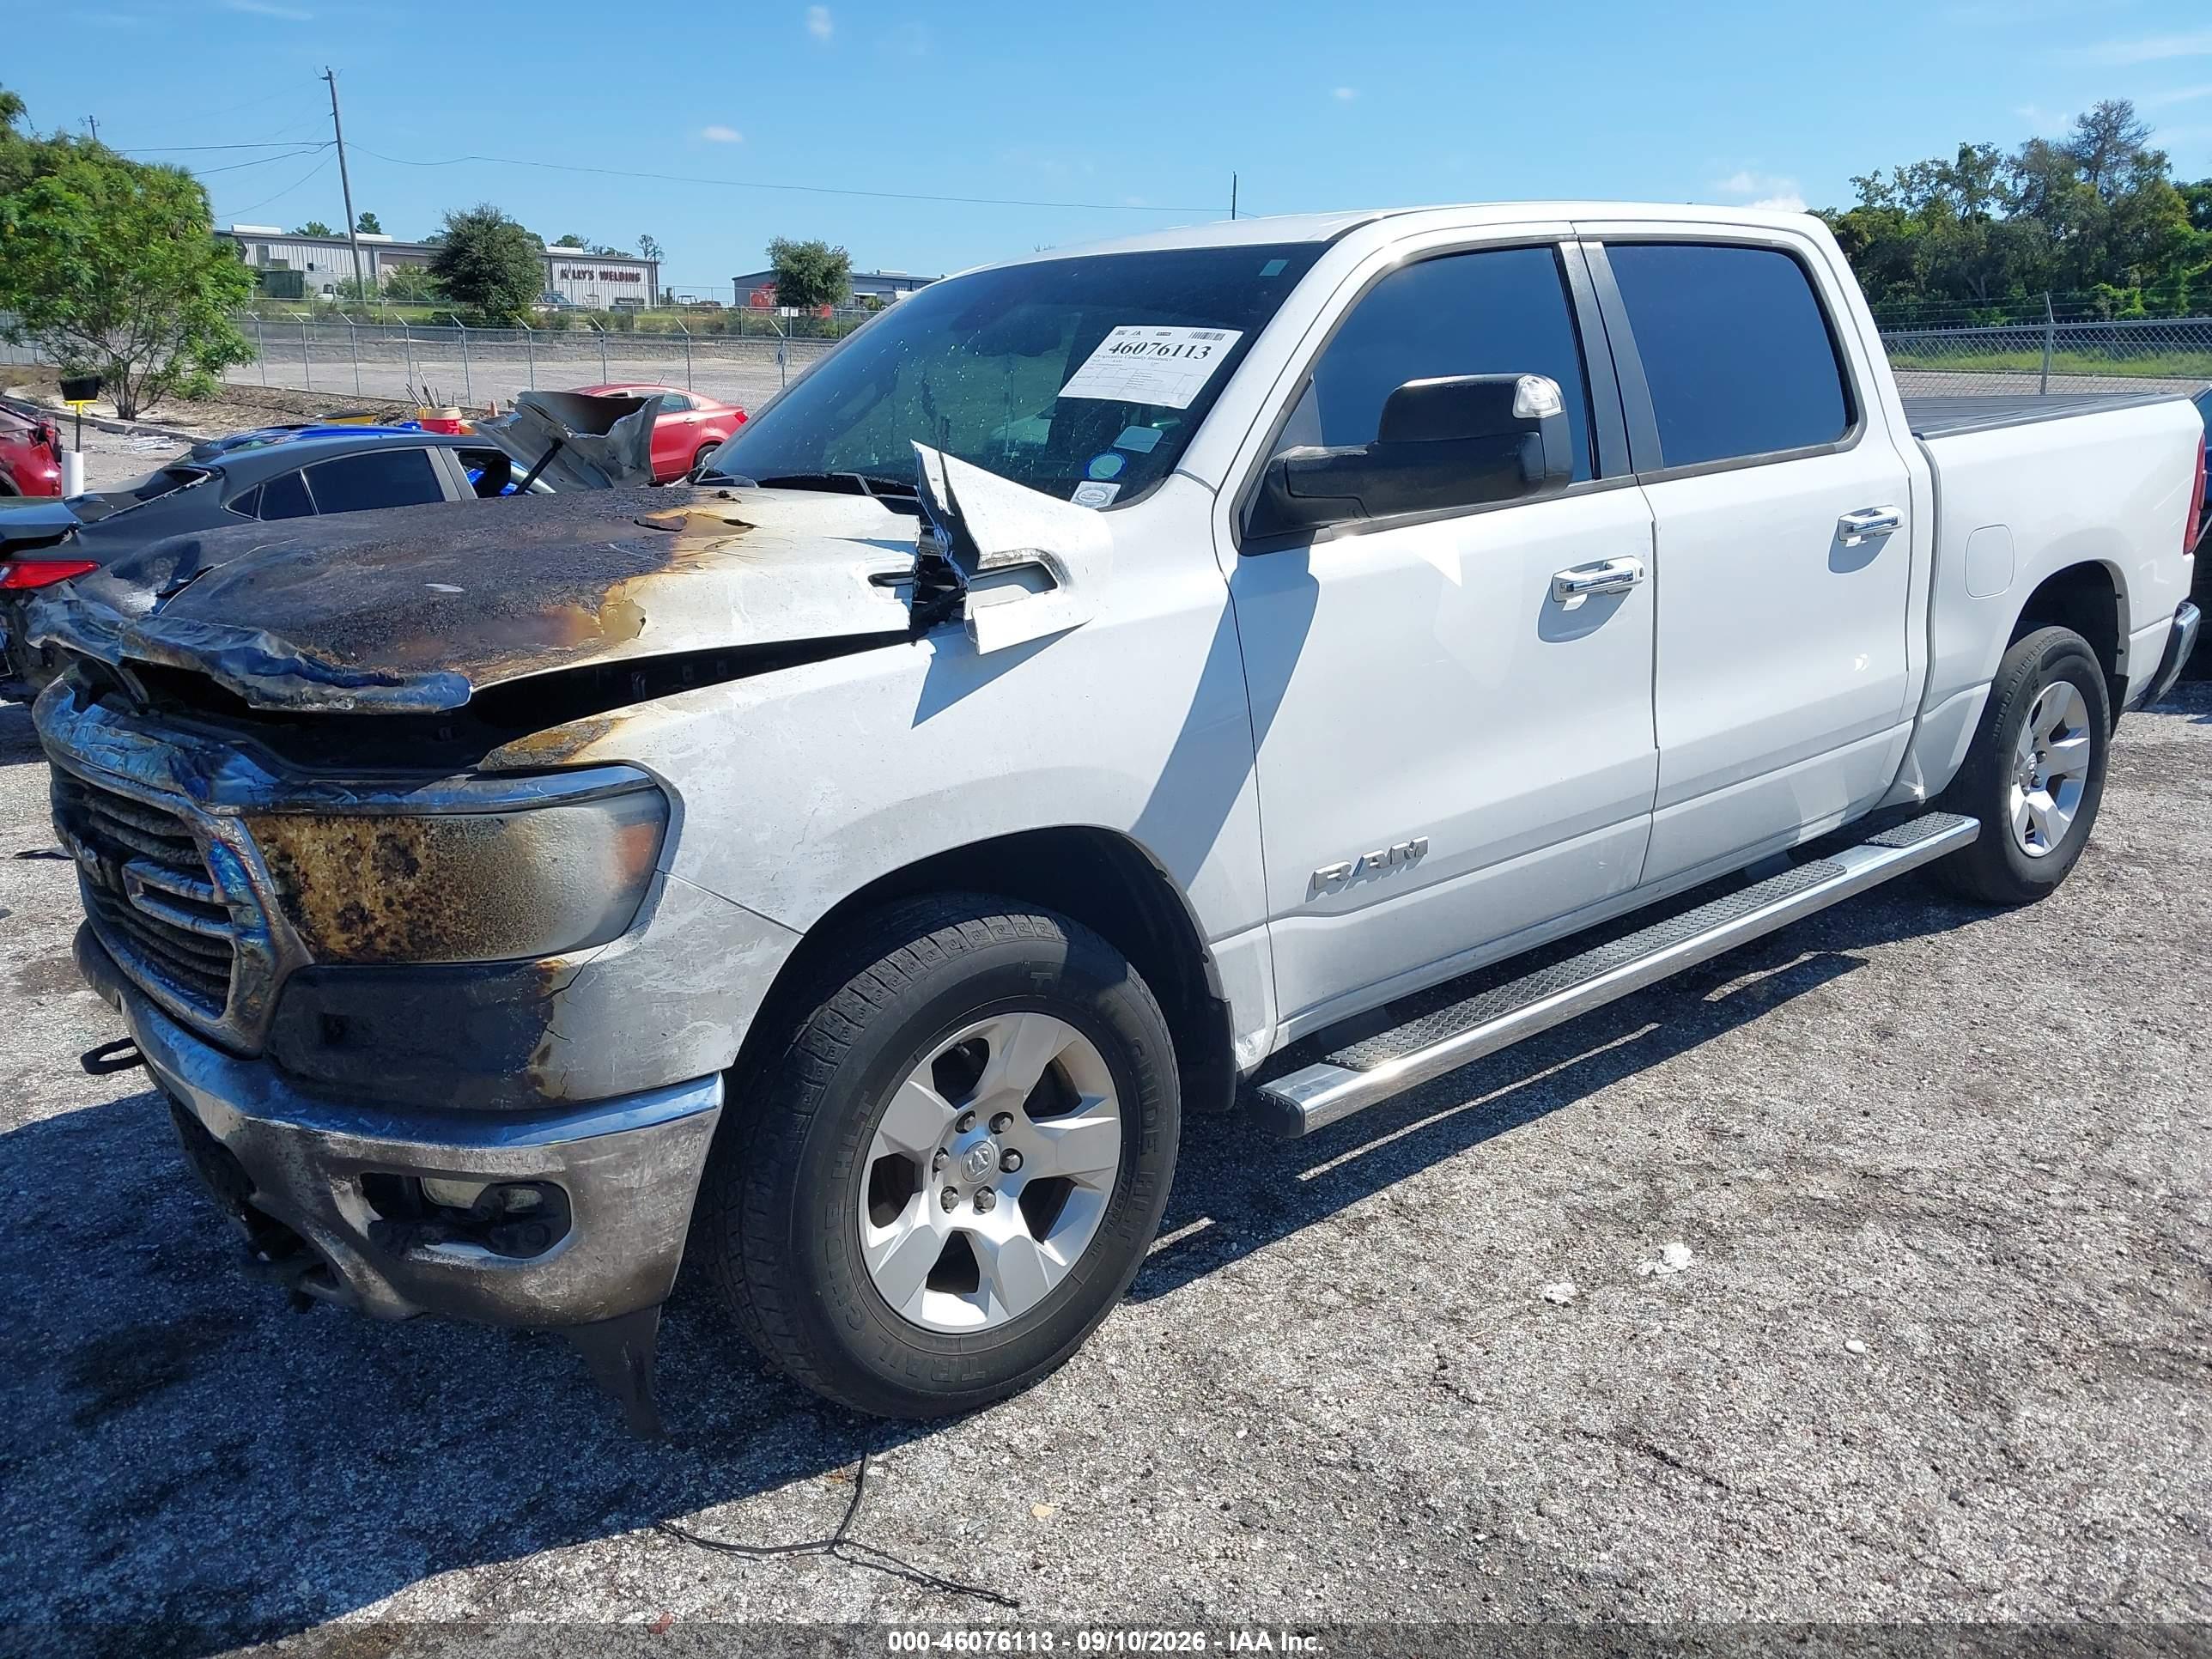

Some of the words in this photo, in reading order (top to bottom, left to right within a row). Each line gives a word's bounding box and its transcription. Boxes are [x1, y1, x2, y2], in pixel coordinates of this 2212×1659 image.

[599, 270, 641, 283] WELDING
[777, 349, 783, 364] 6
[1108, 341, 1212, 360] 46076113
[1309, 835, 1430, 896] RAM
